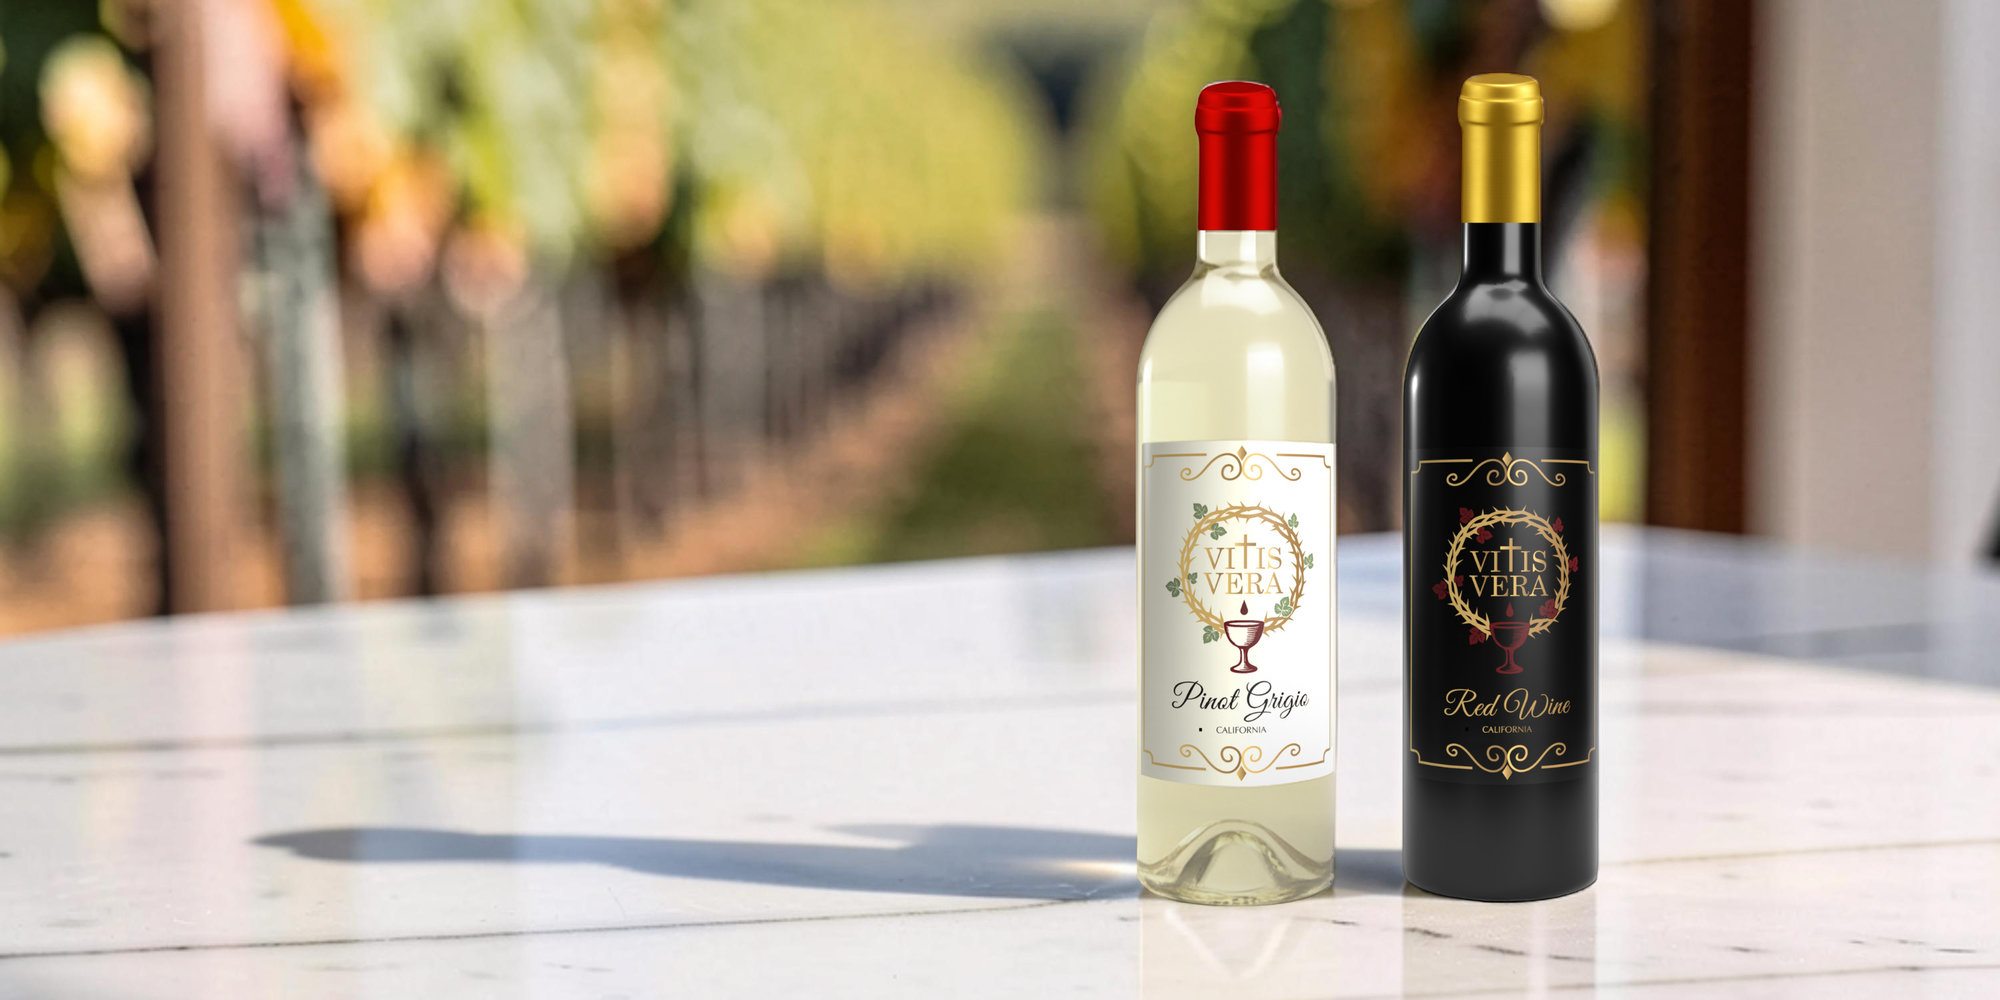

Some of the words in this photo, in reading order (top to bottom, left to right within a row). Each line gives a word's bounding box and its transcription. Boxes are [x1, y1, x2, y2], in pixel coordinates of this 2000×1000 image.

[1204, 572, 1284, 595] VERA
[1469, 574, 1549, 597] VERA
[1171, 680, 1240, 710] Pinot
[1243, 680, 1309, 722] Grigio
[1443, 688, 1501, 717] Red
[1503, 688, 1571, 720] Wine
[1215, 725, 1267, 735] CALIFORNIA
[1481, 725, 1533, 734] CALIFORNIA
